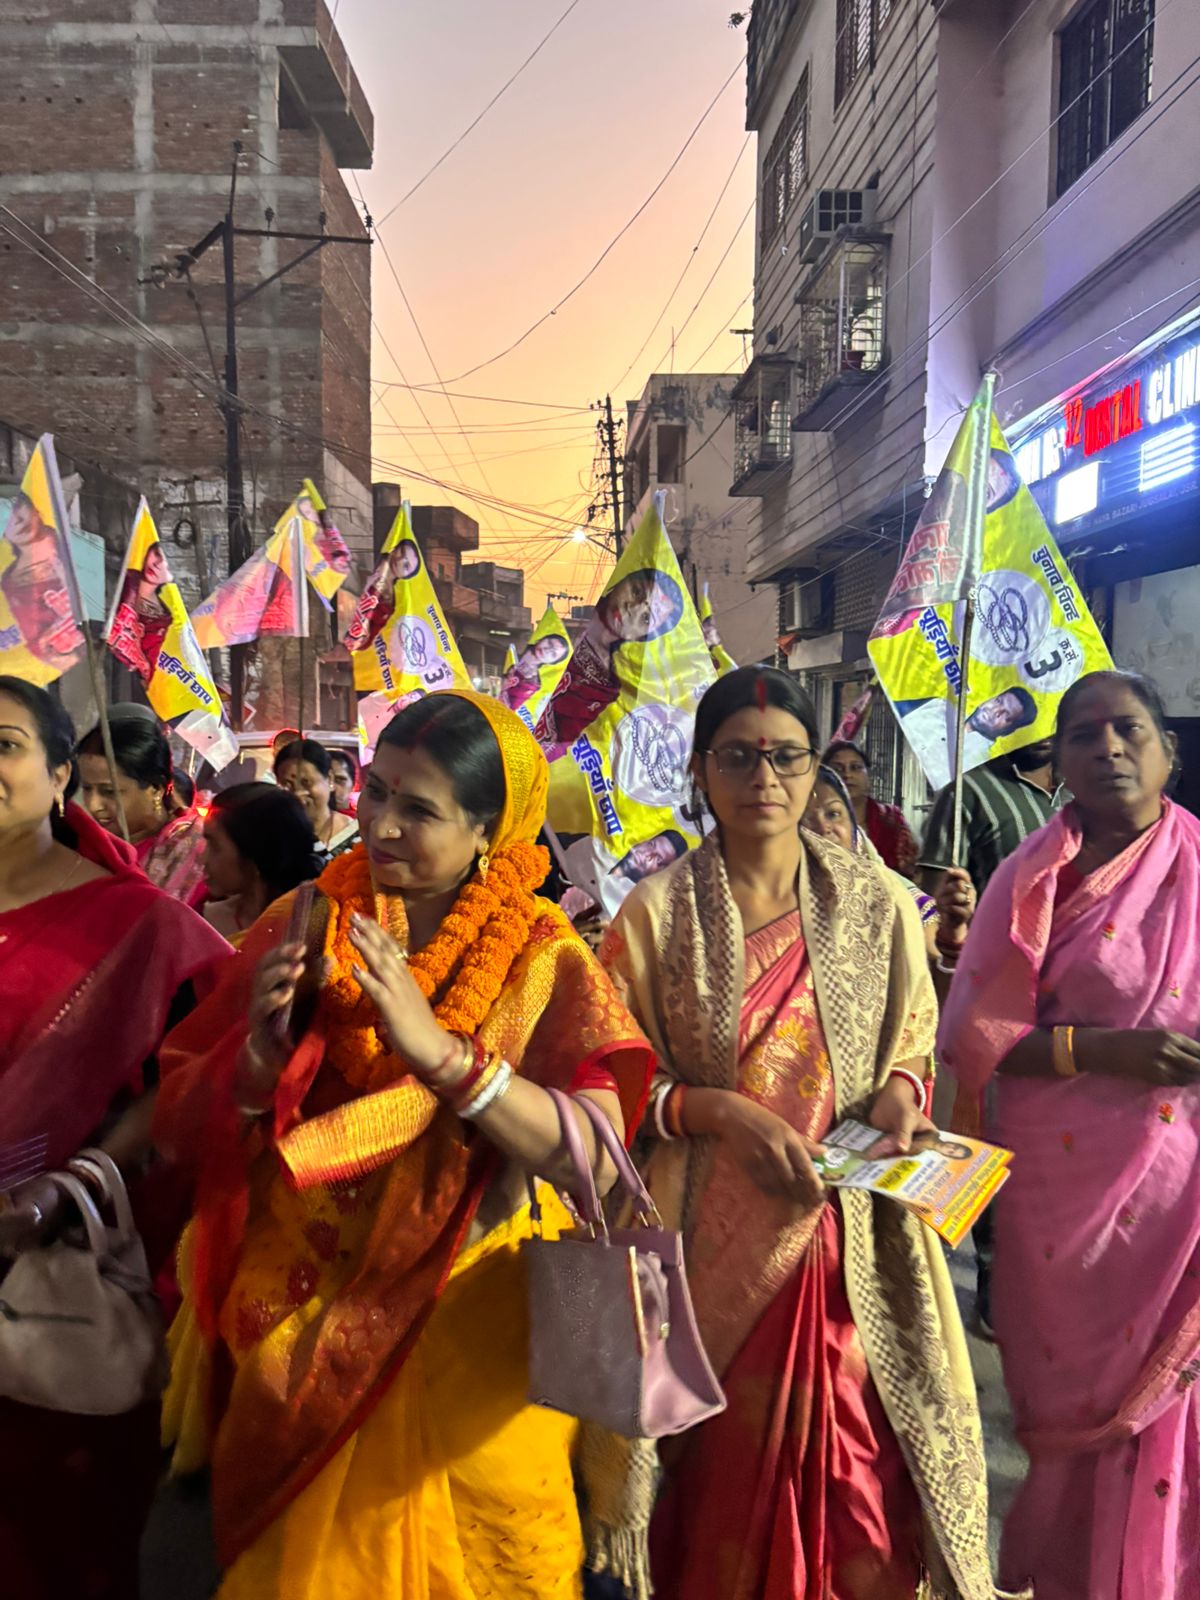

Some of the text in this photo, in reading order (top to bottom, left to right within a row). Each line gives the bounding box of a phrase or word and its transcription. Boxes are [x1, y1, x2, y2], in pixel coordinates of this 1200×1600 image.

[1064, 398, 1082, 448] 32
[1084, 379, 1142, 456] DENTAL
[1032, 545, 1080, 621] चुनाव चिन्ह
[919, 605, 960, 660] चूड़ियाँ
[158, 651, 213, 704] चूड़ियाँ छाप
[424, 668, 444, 684] 3
[1024, 650, 1062, 679] 3
[573, 733, 623, 836] चूड़ियाँ छाप
